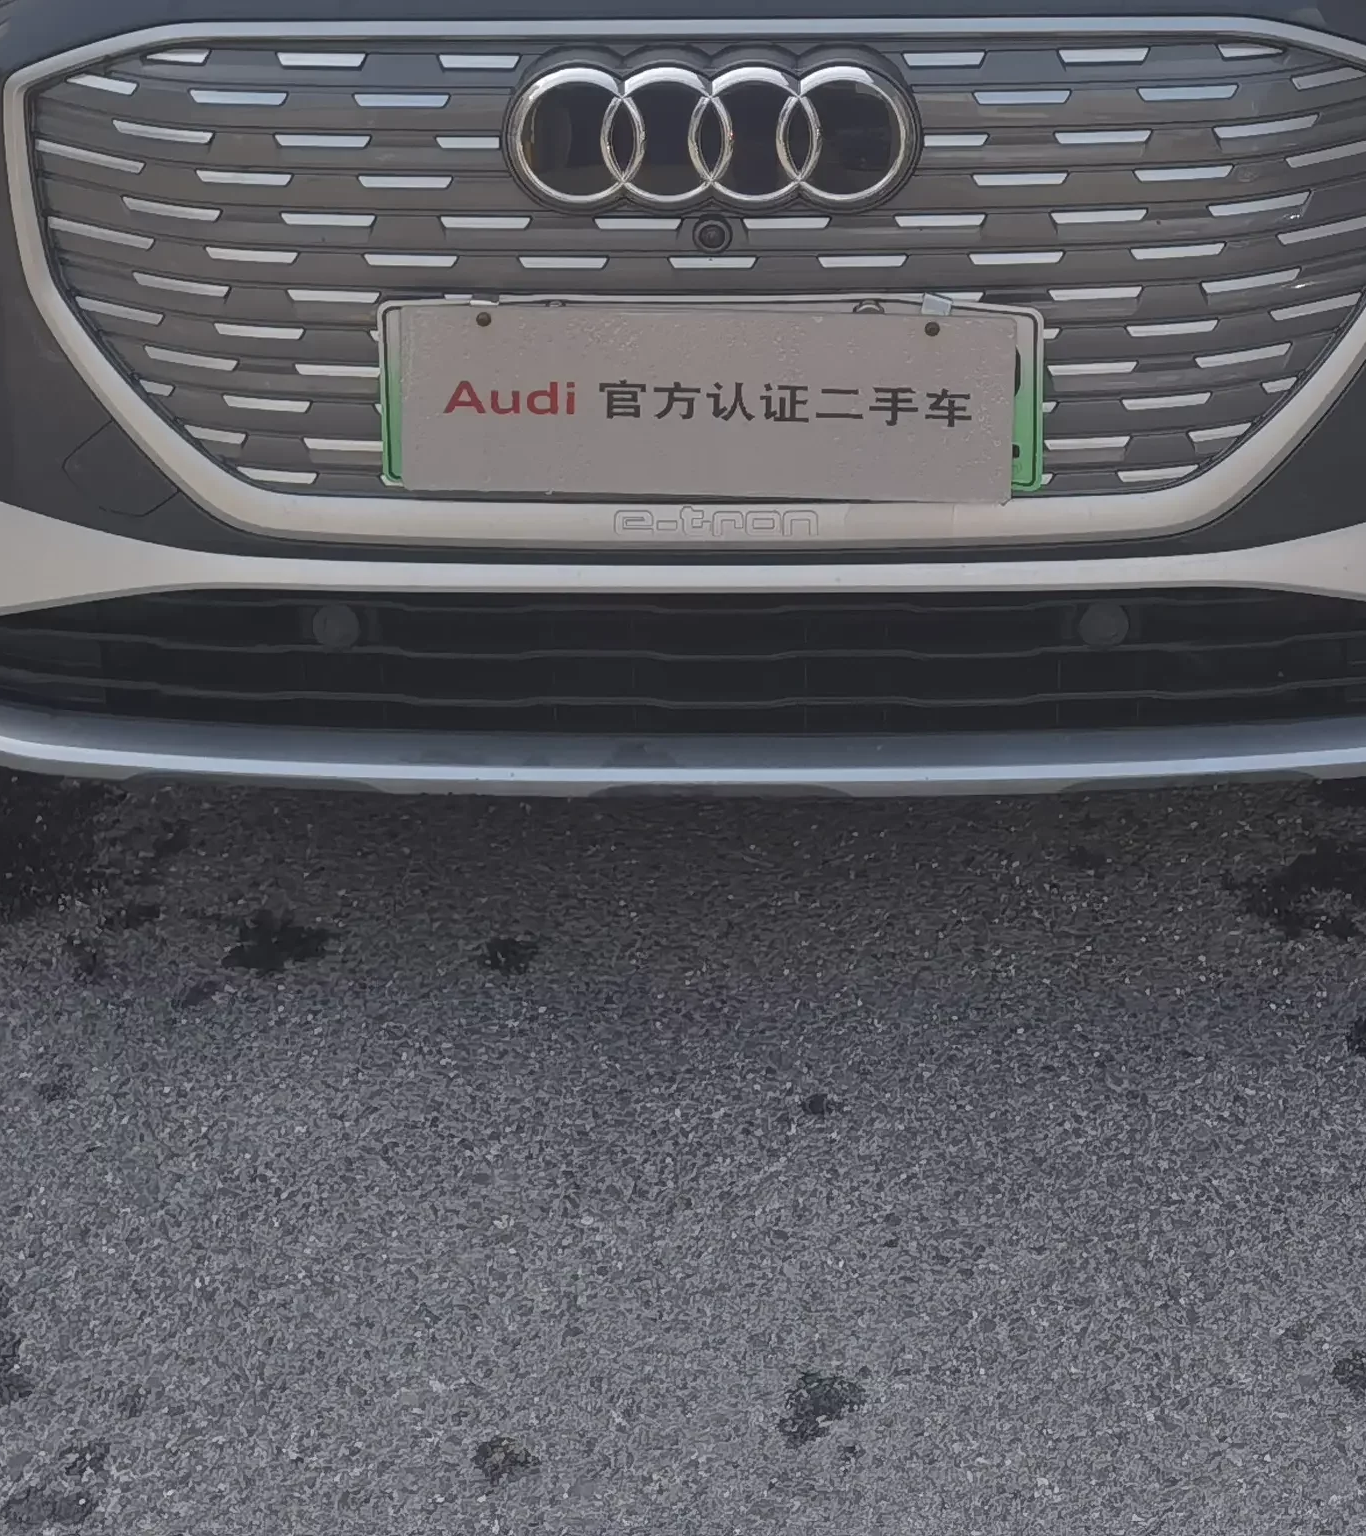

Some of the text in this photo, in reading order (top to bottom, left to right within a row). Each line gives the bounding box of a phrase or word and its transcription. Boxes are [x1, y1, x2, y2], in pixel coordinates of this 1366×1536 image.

[443, 379, 973, 427] Audi 官方认证二手车
[613, 505, 819, 538] e-tron
